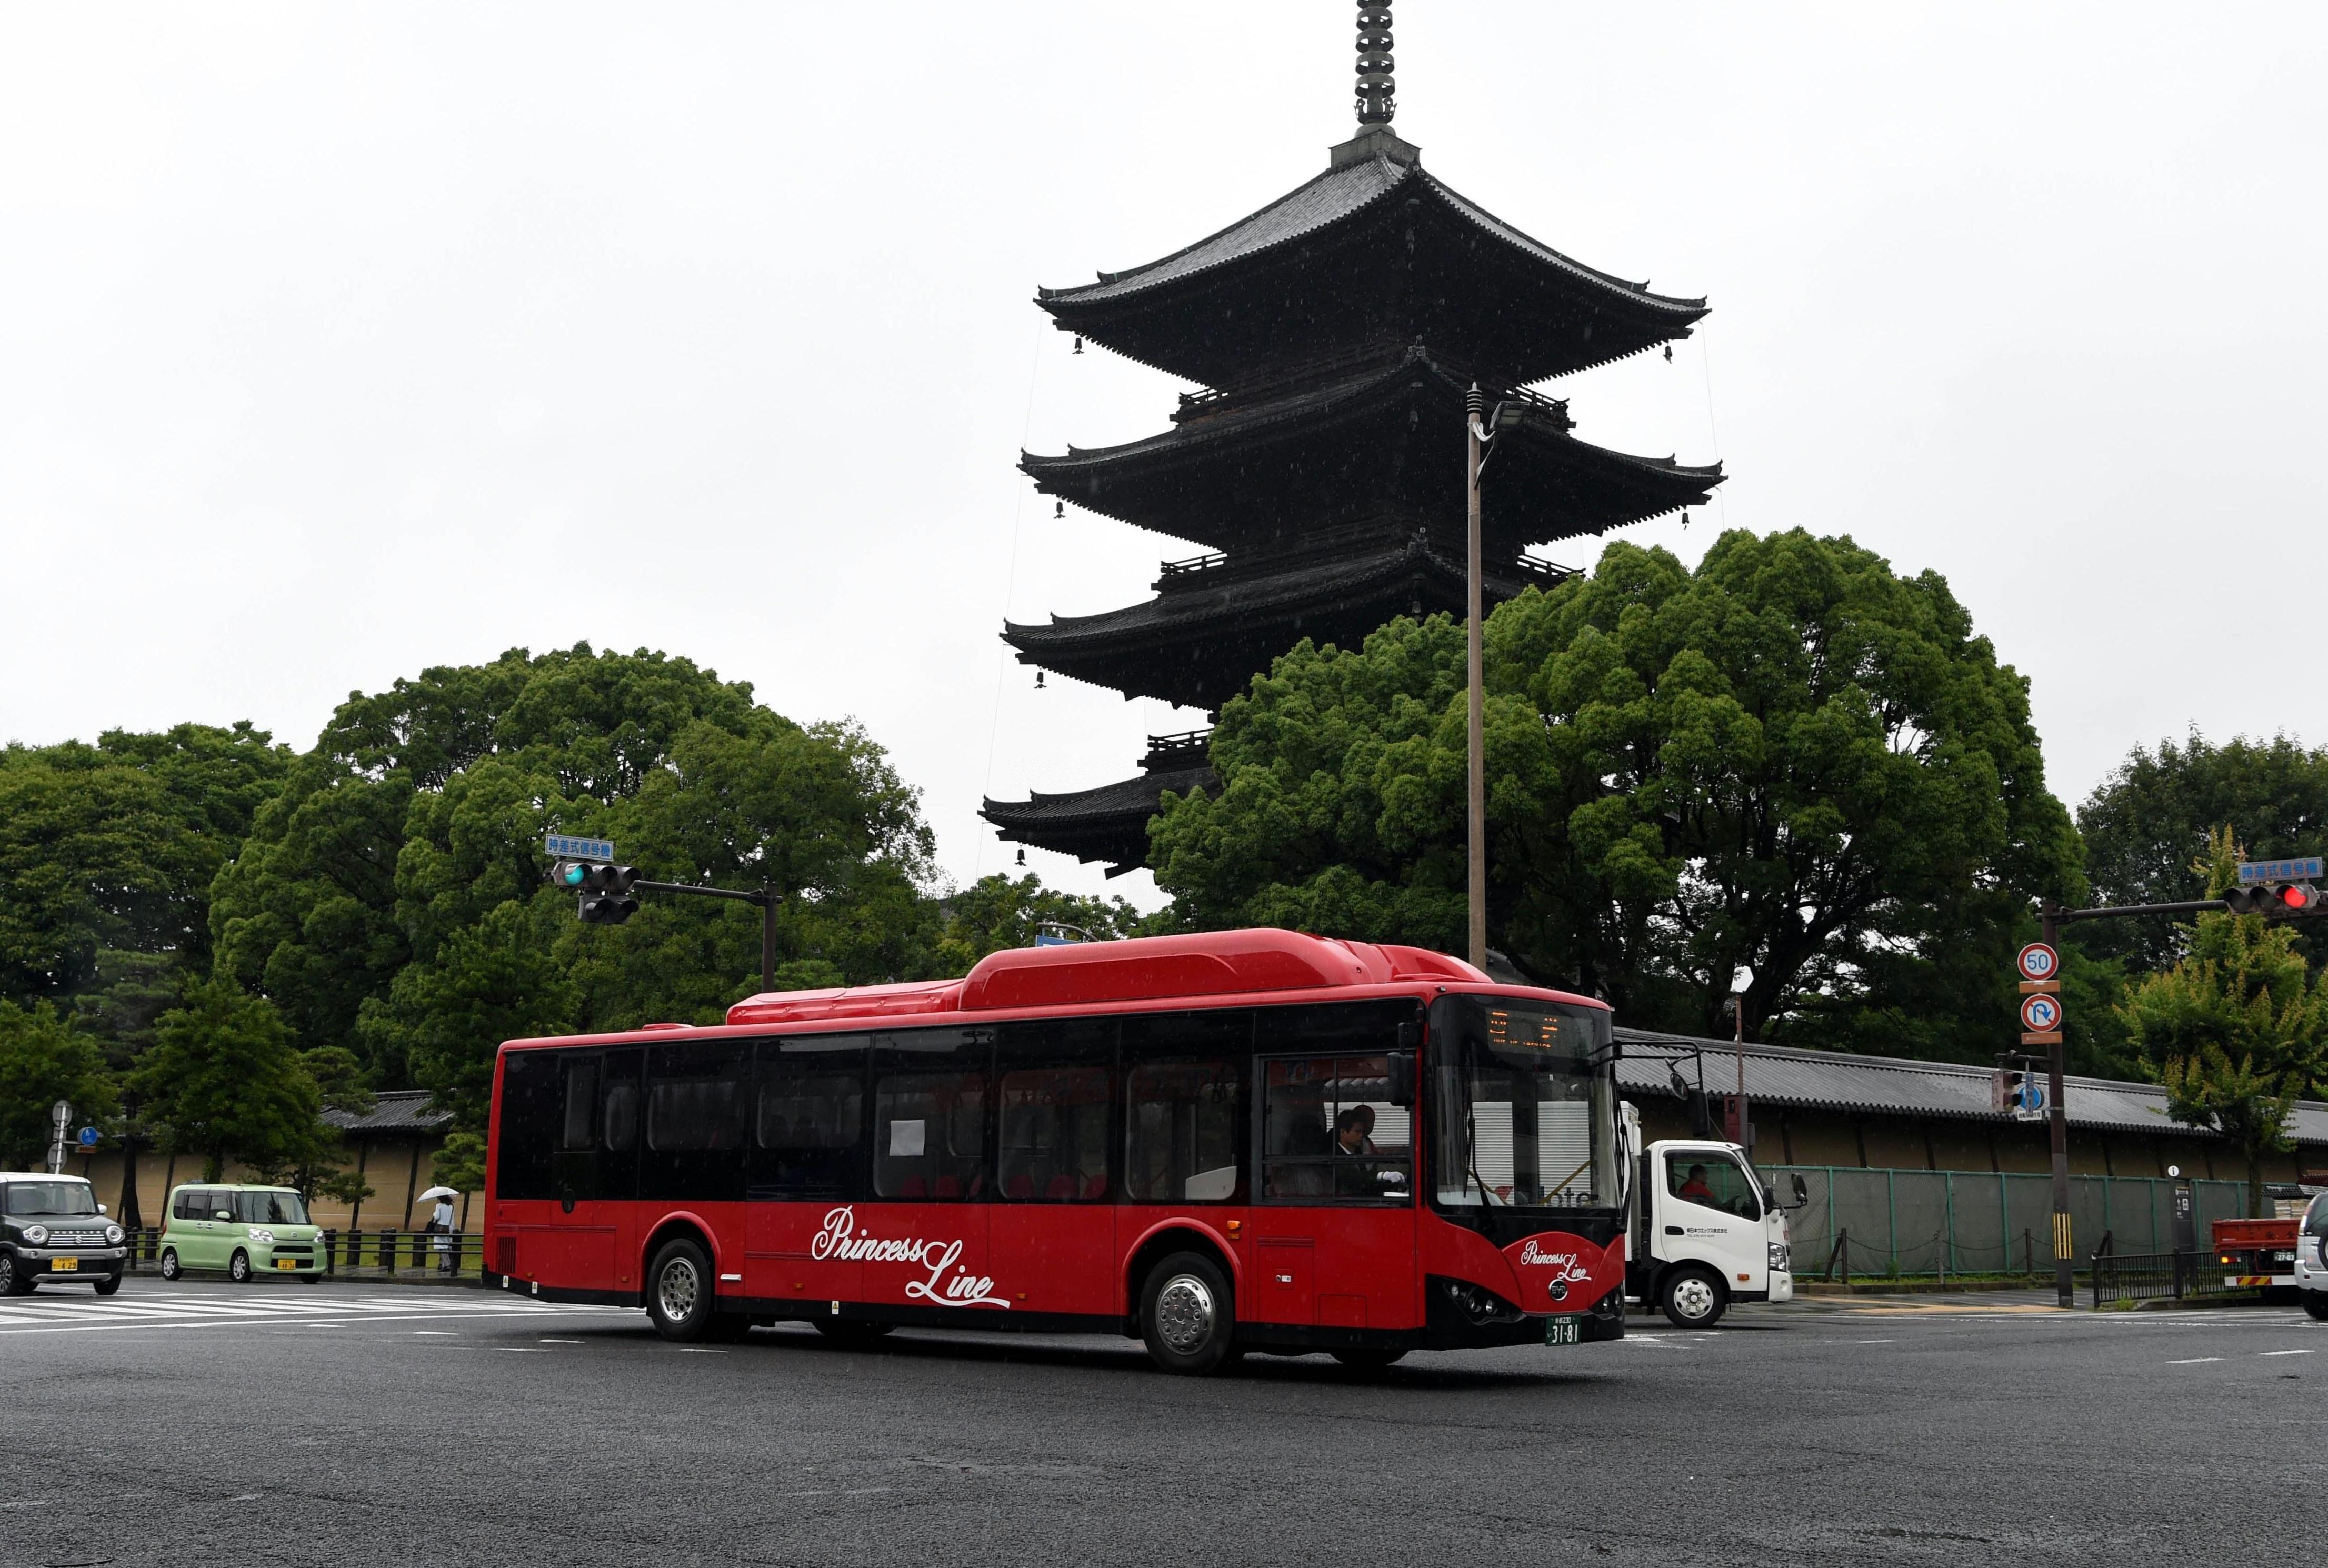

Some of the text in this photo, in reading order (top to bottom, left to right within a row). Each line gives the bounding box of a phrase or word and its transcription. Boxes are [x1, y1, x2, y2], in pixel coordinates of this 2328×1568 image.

[549, 838, 610, 857] 時差式信号機
[2242, 861, 2318, 878] 時差式信号機
[2027, 954, 2048, 970] 50
[812, 1205, 1011, 1309] Princess Line
[1521, 1240, 1592, 1282] Princess Line
[1552, 1286, 1566, 1294] BYD
[1552, 1324, 1578, 1343] 31-81
